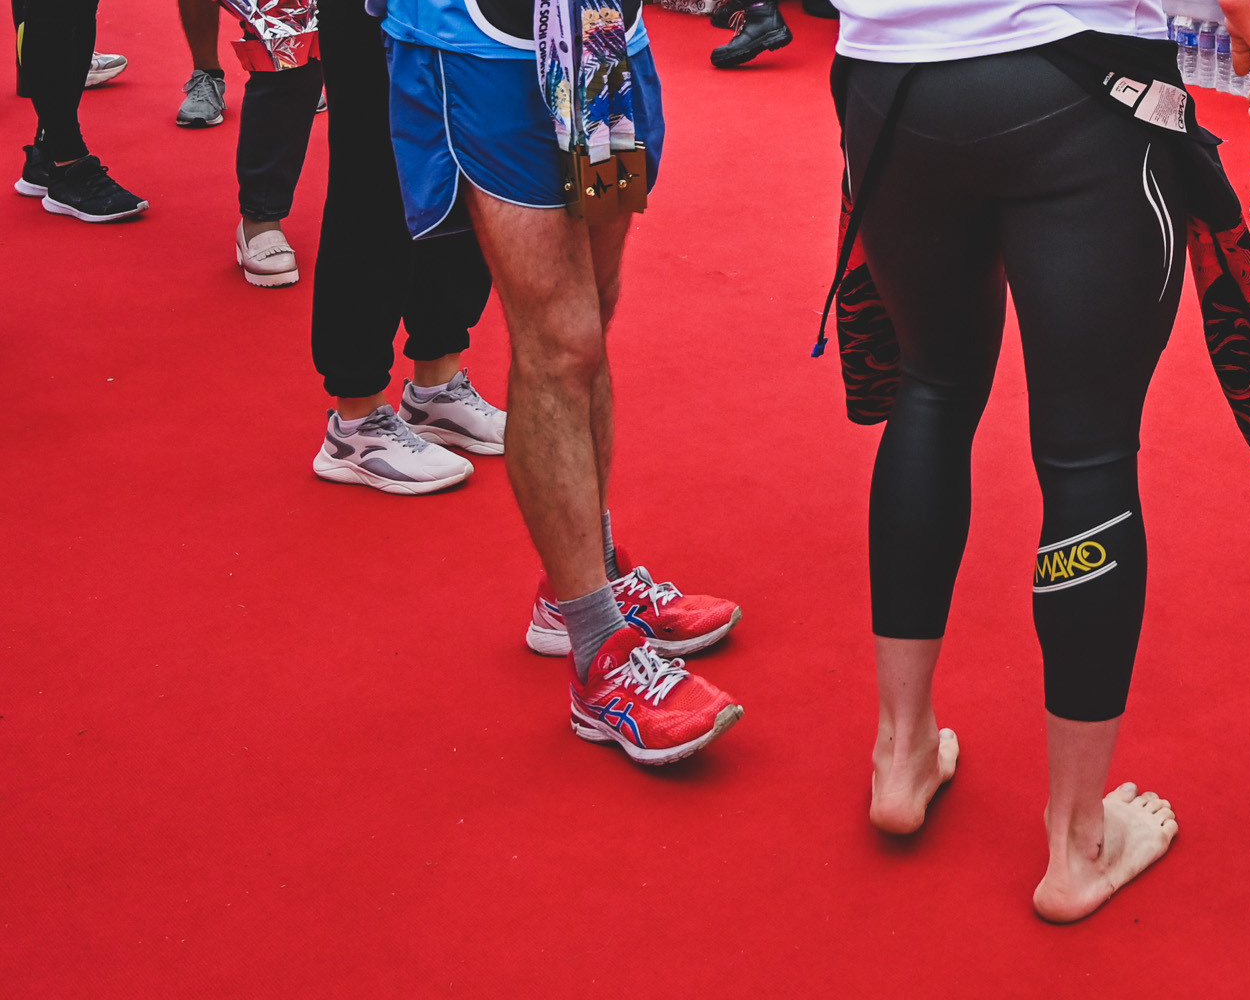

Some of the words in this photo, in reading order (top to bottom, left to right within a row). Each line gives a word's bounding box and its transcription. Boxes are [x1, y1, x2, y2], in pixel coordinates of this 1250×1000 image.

[539, 9, 550, 40] SOCHI
[1122, 85, 1139, 94] L
[1035, 541, 1106, 584] MAKO
